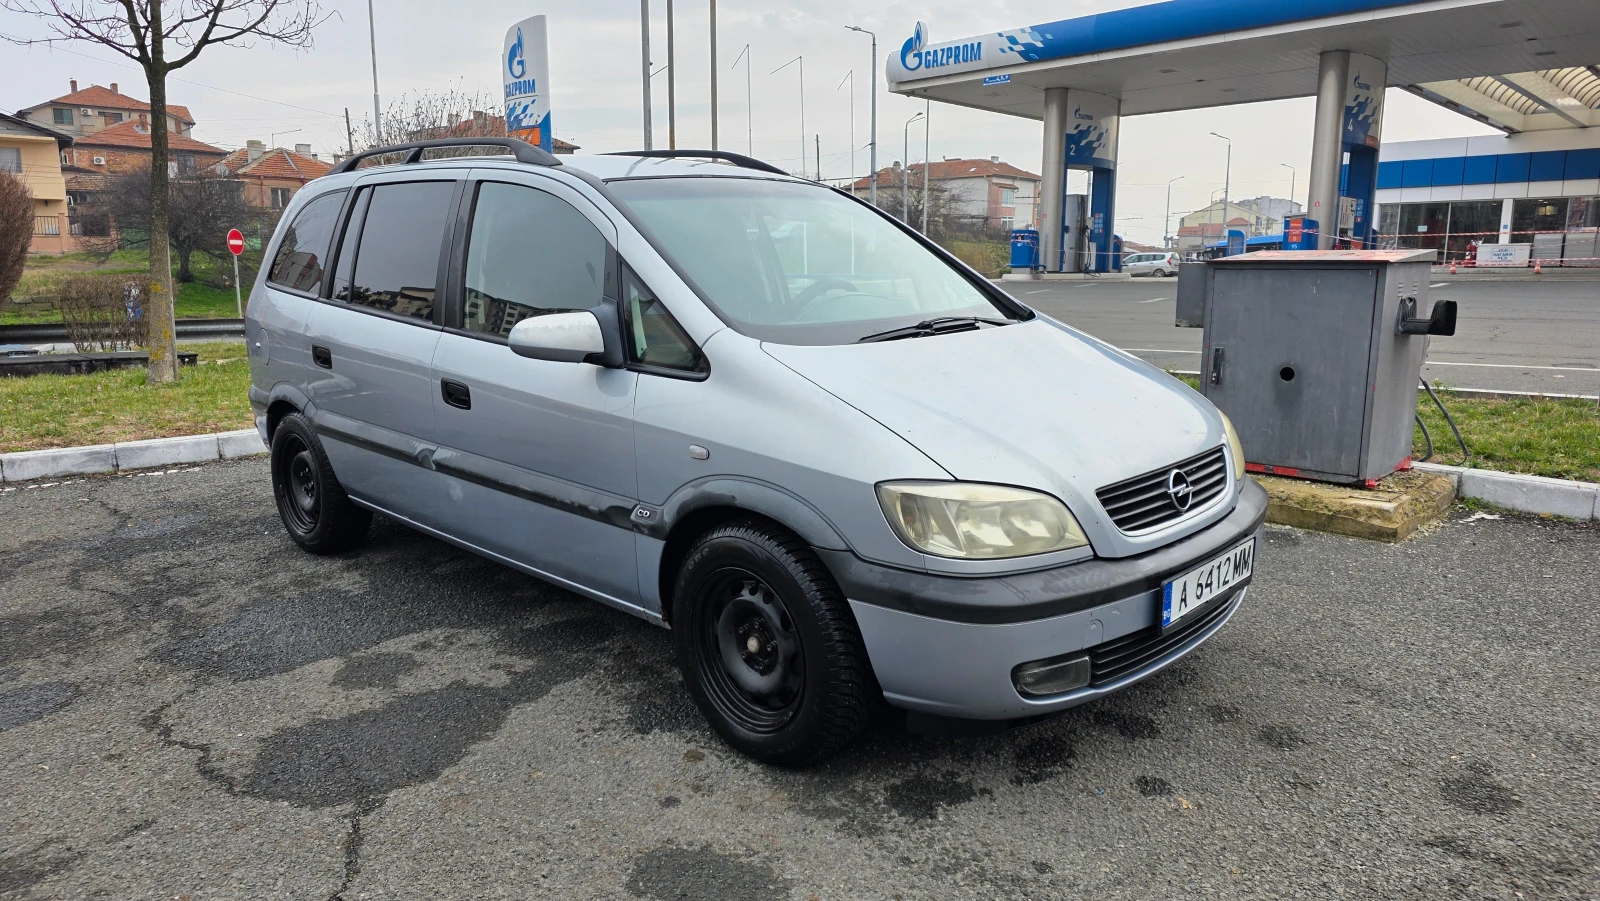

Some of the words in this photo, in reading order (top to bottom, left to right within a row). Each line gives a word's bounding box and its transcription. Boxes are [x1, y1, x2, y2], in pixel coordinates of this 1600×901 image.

[924, 42, 982, 69] GAZPROM
[505, 79, 536, 98] GAZPROM
[1347, 118, 1354, 132] 4
[1069, 144, 1076, 156] 2
[637, 509, 650, 518] CD
[1178, 579, 1188, 612] A
[1195, 556, 1231, 600] 6412
[1232, 544, 1252, 581] MM
